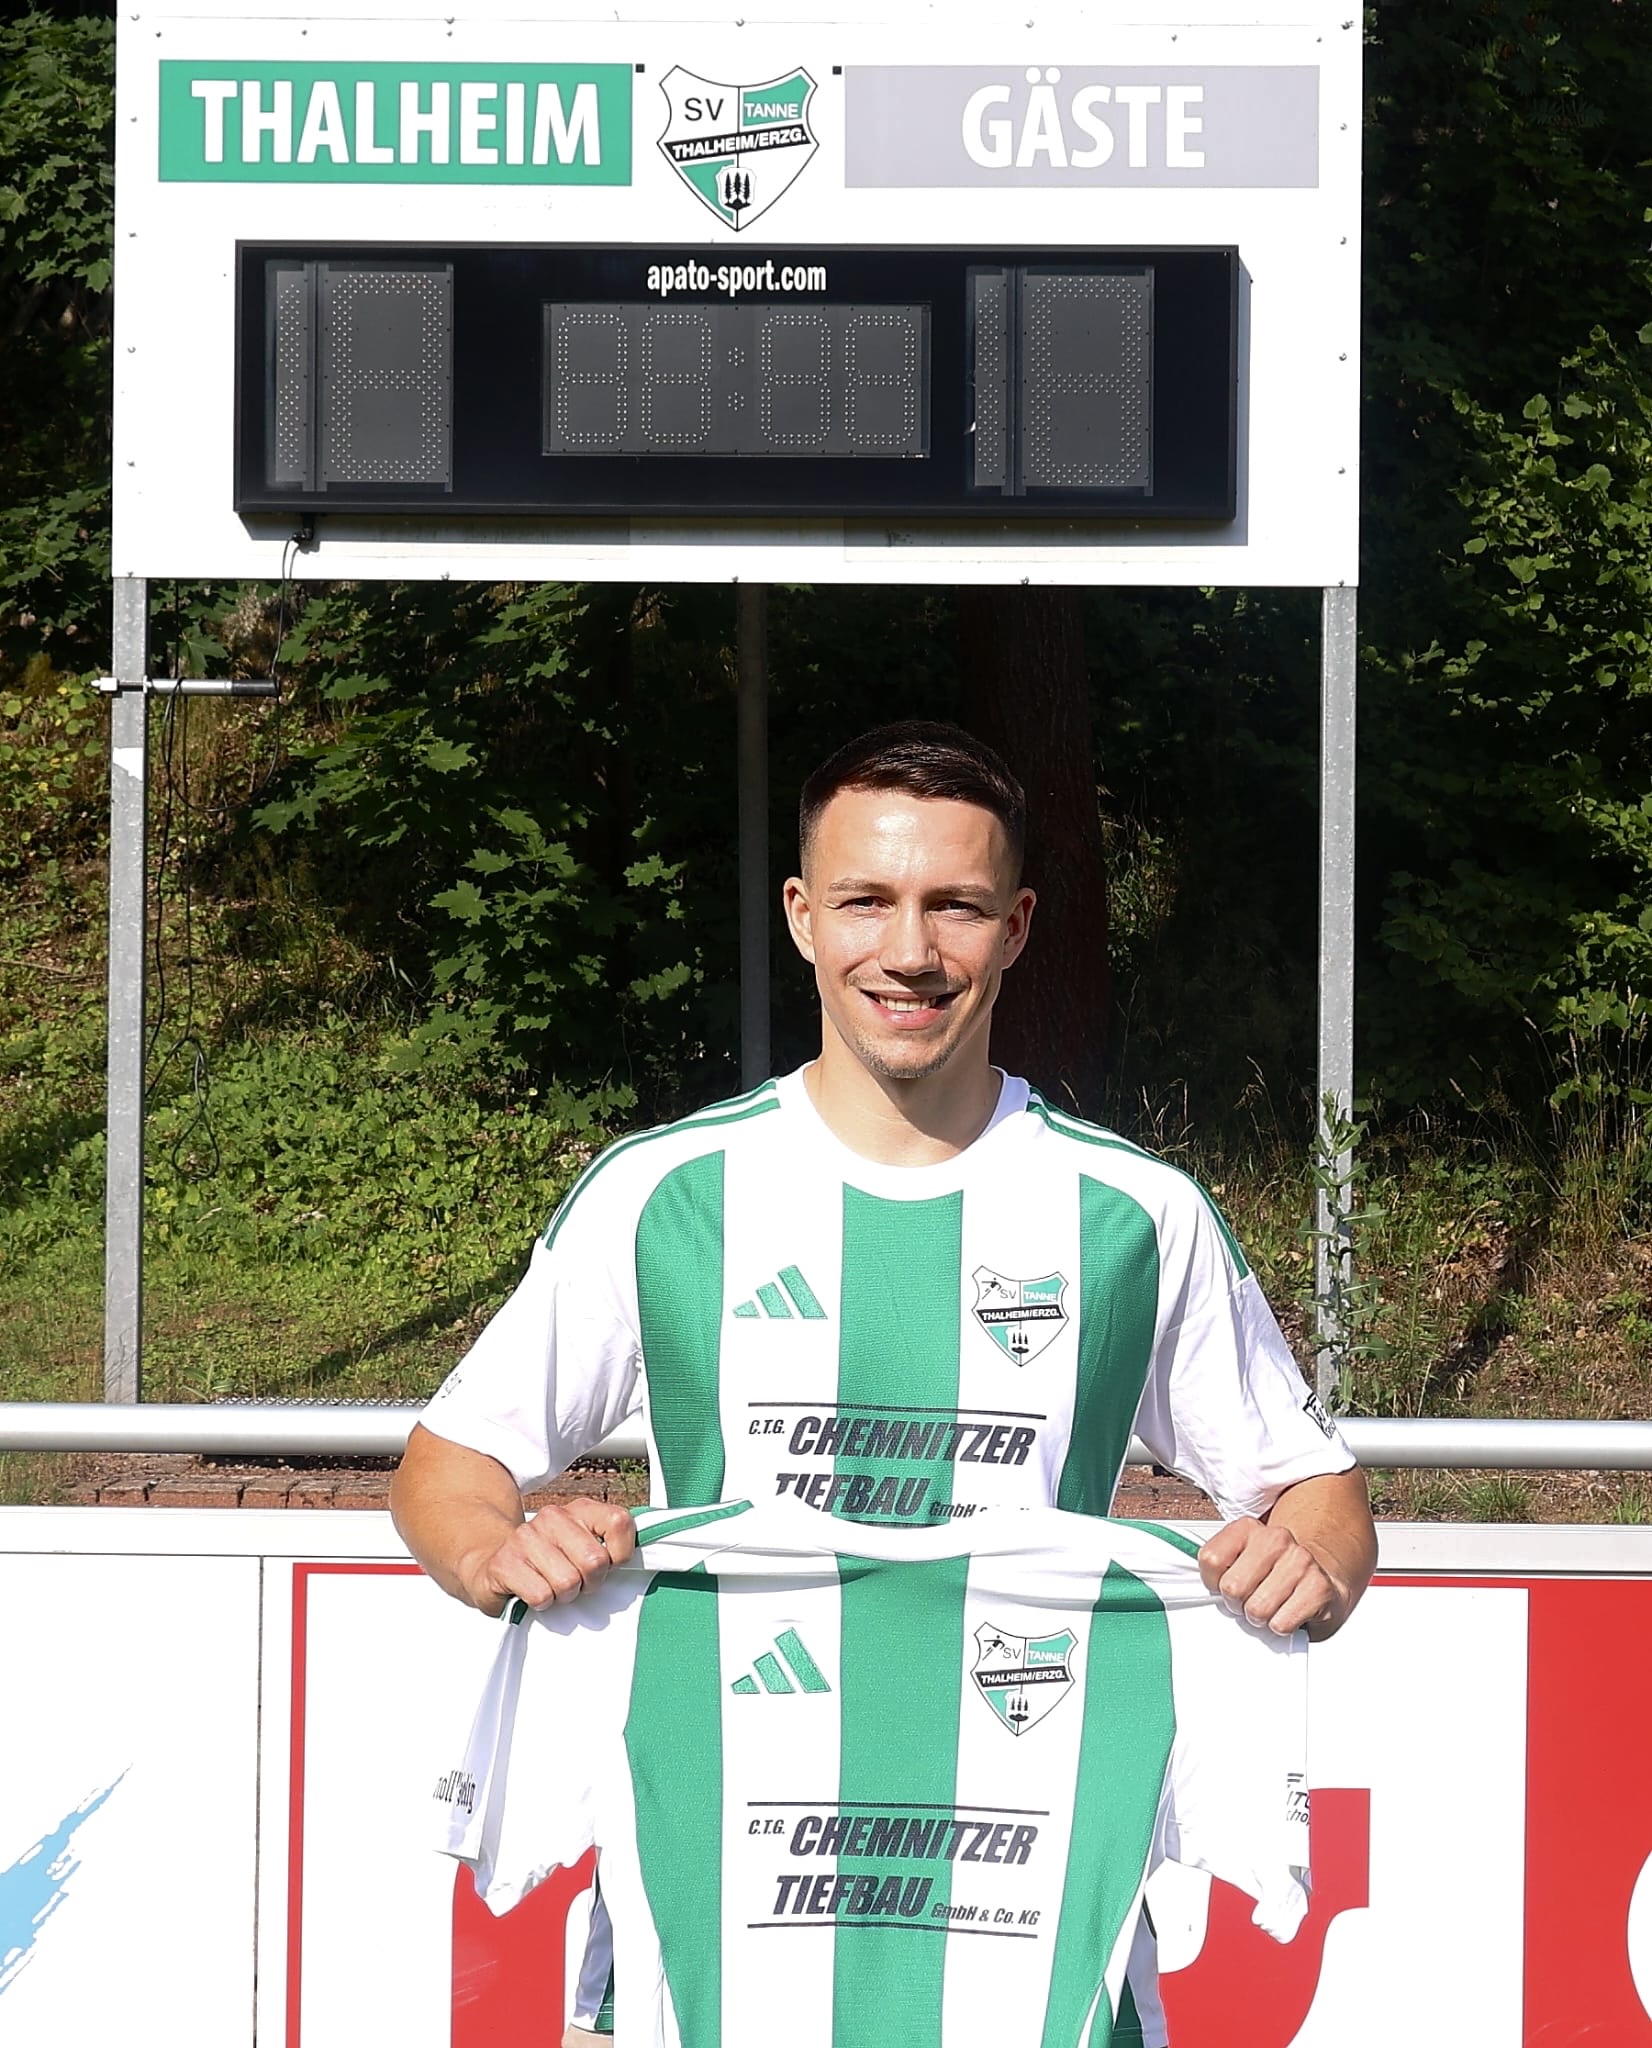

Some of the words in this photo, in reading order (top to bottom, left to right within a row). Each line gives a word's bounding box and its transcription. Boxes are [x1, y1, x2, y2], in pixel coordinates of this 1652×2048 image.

[190, 79, 602, 167] THALHEIM
[684, 97, 724, 122] SV
[744, 102, 799, 119] TANNE
[961, 66, 1206, 169] GÄSTE
[672, 127, 807, 161] THALHEIM/ERZG.
[647, 259, 827, 298] apato-sport.com
[999, 1288, 1017, 1300] SV
[1024, 1291, 1057, 1302] TANNE
[981, 1307, 1060, 1321] THALHEIM/ERZG.
[748, 1419, 785, 1436] C.T.G.
[788, 1415, 1037, 1466] CHEMNITZER
[929, 1501, 977, 1519] GmbH
[1003, 1647, 1022, 1659] SV
[1029, 1650, 1066, 1662] TANNE
[981, 1669, 1066, 1685] THALHEIM/ERZG.
[748, 1819, 786, 1836] C.T.G.
[789, 1815, 1039, 1866] CHEMNITZER
[772, 1874, 934, 1918] TIEFBAU
[931, 1902, 977, 1922] GmbH
[978, 1908, 989, 1922] &
[993, 1907, 1014, 1924] Co.
[1018, 1909, 1041, 1926] KG
